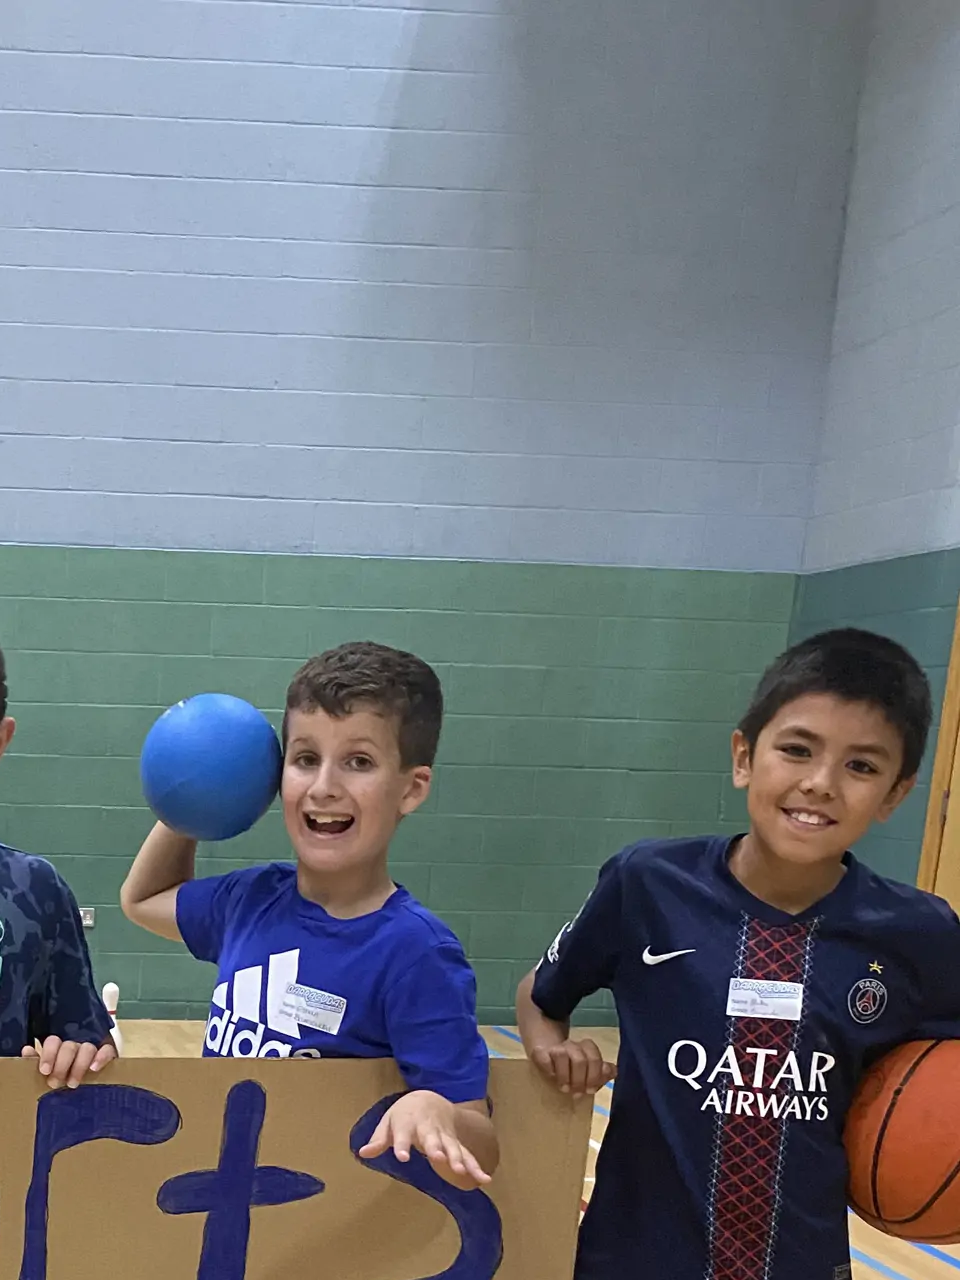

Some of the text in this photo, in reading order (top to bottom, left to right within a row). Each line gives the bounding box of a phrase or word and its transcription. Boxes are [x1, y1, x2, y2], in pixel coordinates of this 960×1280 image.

[858, 980, 885, 996] PARIS
[205, 1009, 322, 1058] dida
[667, 1039, 836, 1093] QATAR
[700, 1088, 829, 1121] AIRWAYS
